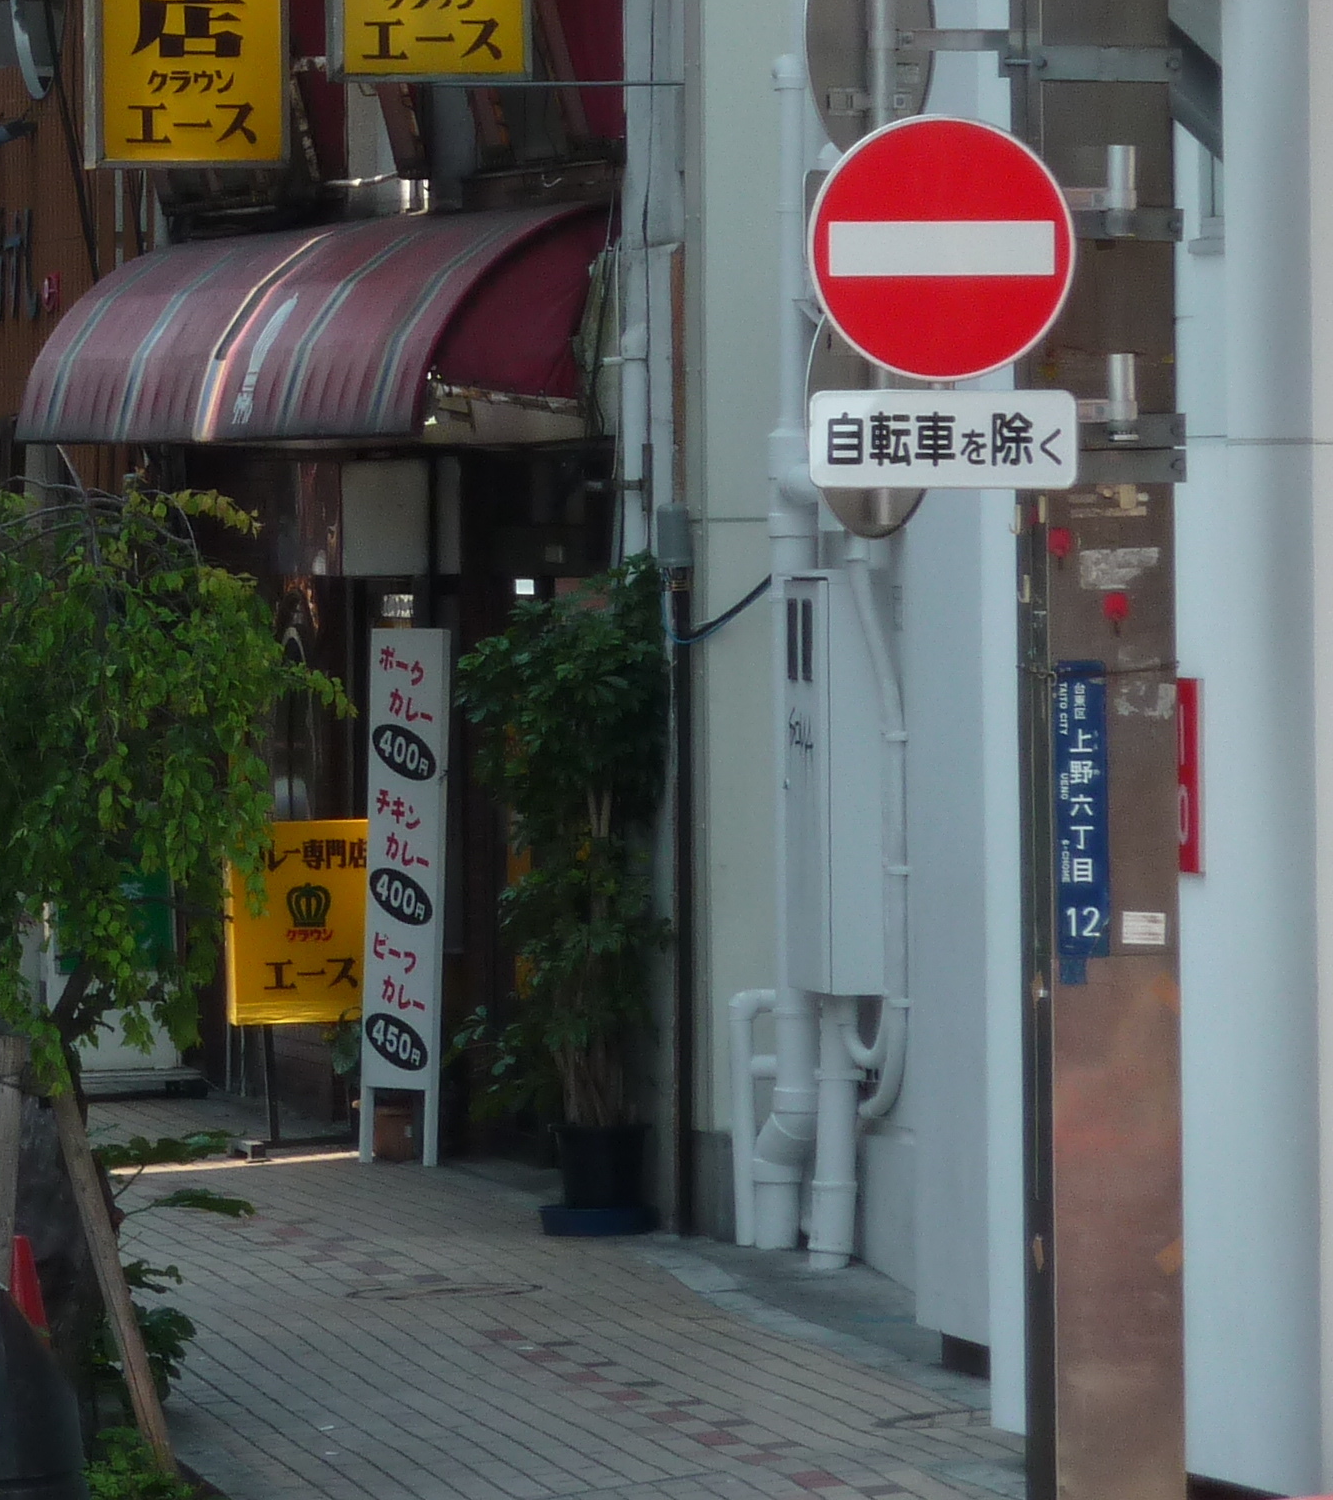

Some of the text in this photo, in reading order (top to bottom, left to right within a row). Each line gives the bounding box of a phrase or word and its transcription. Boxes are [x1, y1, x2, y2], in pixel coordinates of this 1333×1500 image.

[363, 18, 502, 61] エース
[147, 68, 236, 96] クラウン
[126, 103, 258, 145] エース
[826, 411, 1064, 466] 自転車を除く
[379, 645, 425, 687] ポーク
[388, 688, 434, 724] カレー
[1059, 682, 1068, 736] TAITO CITY
[378, 729, 431, 777] 400円
[1060, 772, 1069, 800] UENO
[1069, 728, 1095, 884] 上野六丁目
[374, 789, 422, 831] チキン
[384, 832, 431, 869] カレー
[374, 873, 427, 922] 400円
[285, 926, 335, 943] クラウン
[1066, 906, 1102, 938] 12
[371, 931, 418, 974] ビーフ
[263, 957, 359, 992] エース
[380, 974, 427, 1013] カレー
[370, 1019, 422, 1067] 450円
